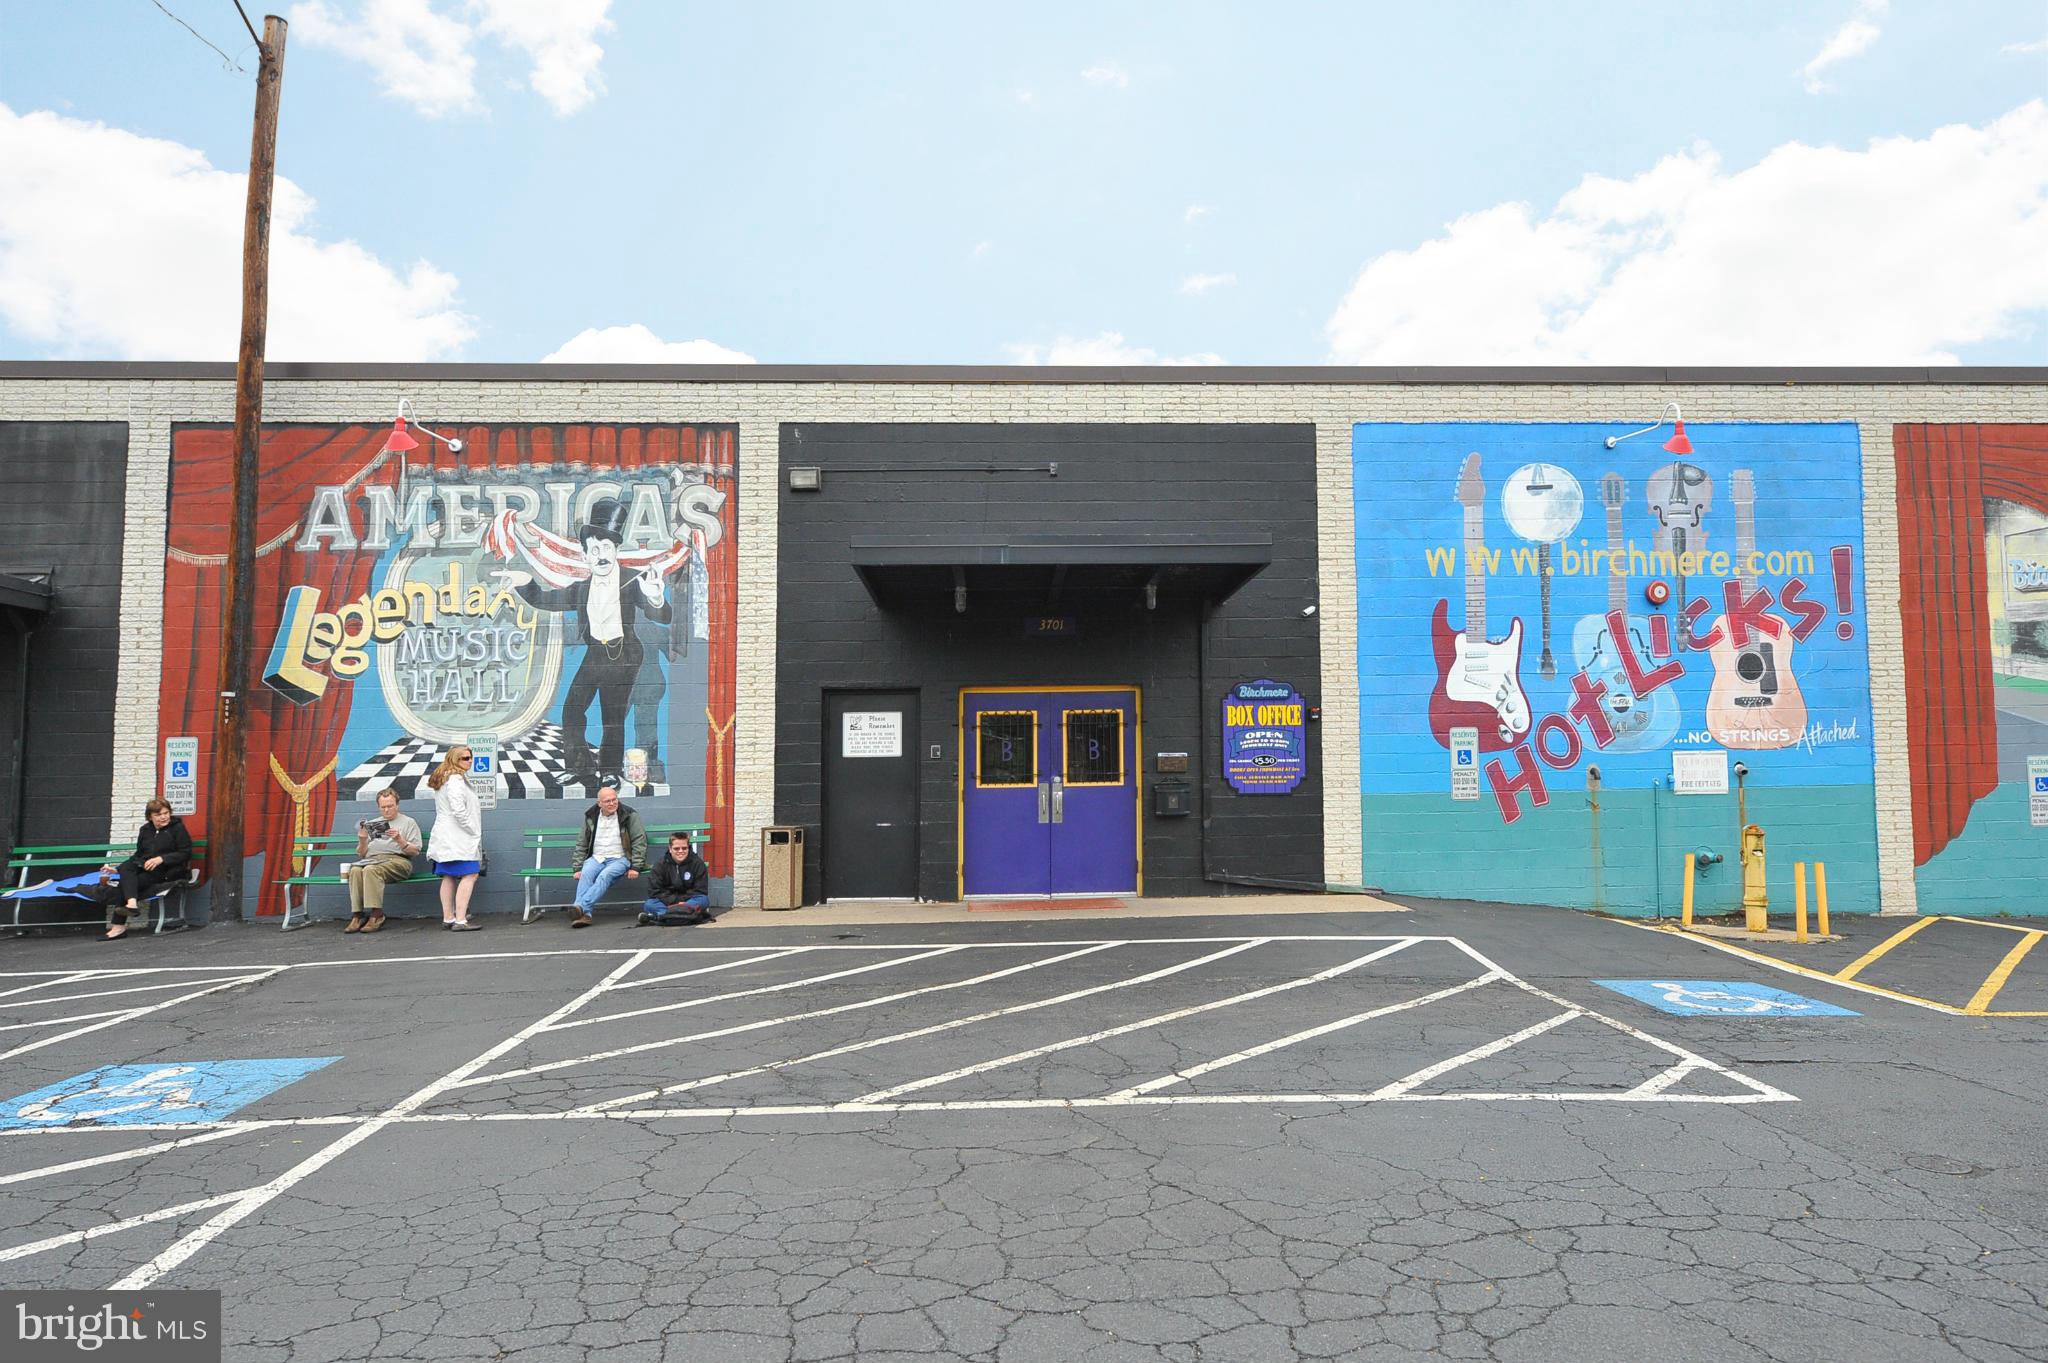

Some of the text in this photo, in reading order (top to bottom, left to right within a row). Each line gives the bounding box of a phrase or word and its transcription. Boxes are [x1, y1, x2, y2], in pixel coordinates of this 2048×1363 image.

[1039, 619, 1064, 630] 3701
[398, 628, 530, 667] MUSIC
[411, 668, 521, 704] HALL
[1239, 685, 1289, 698] Birchmere
[1226, 704, 1303, 727] BOX OFFICE
[1244, 731, 1284, 739] OPEN
[1719, 728, 1790, 744] STRINGS
[1254, 757, 1275, 765] $5.50
